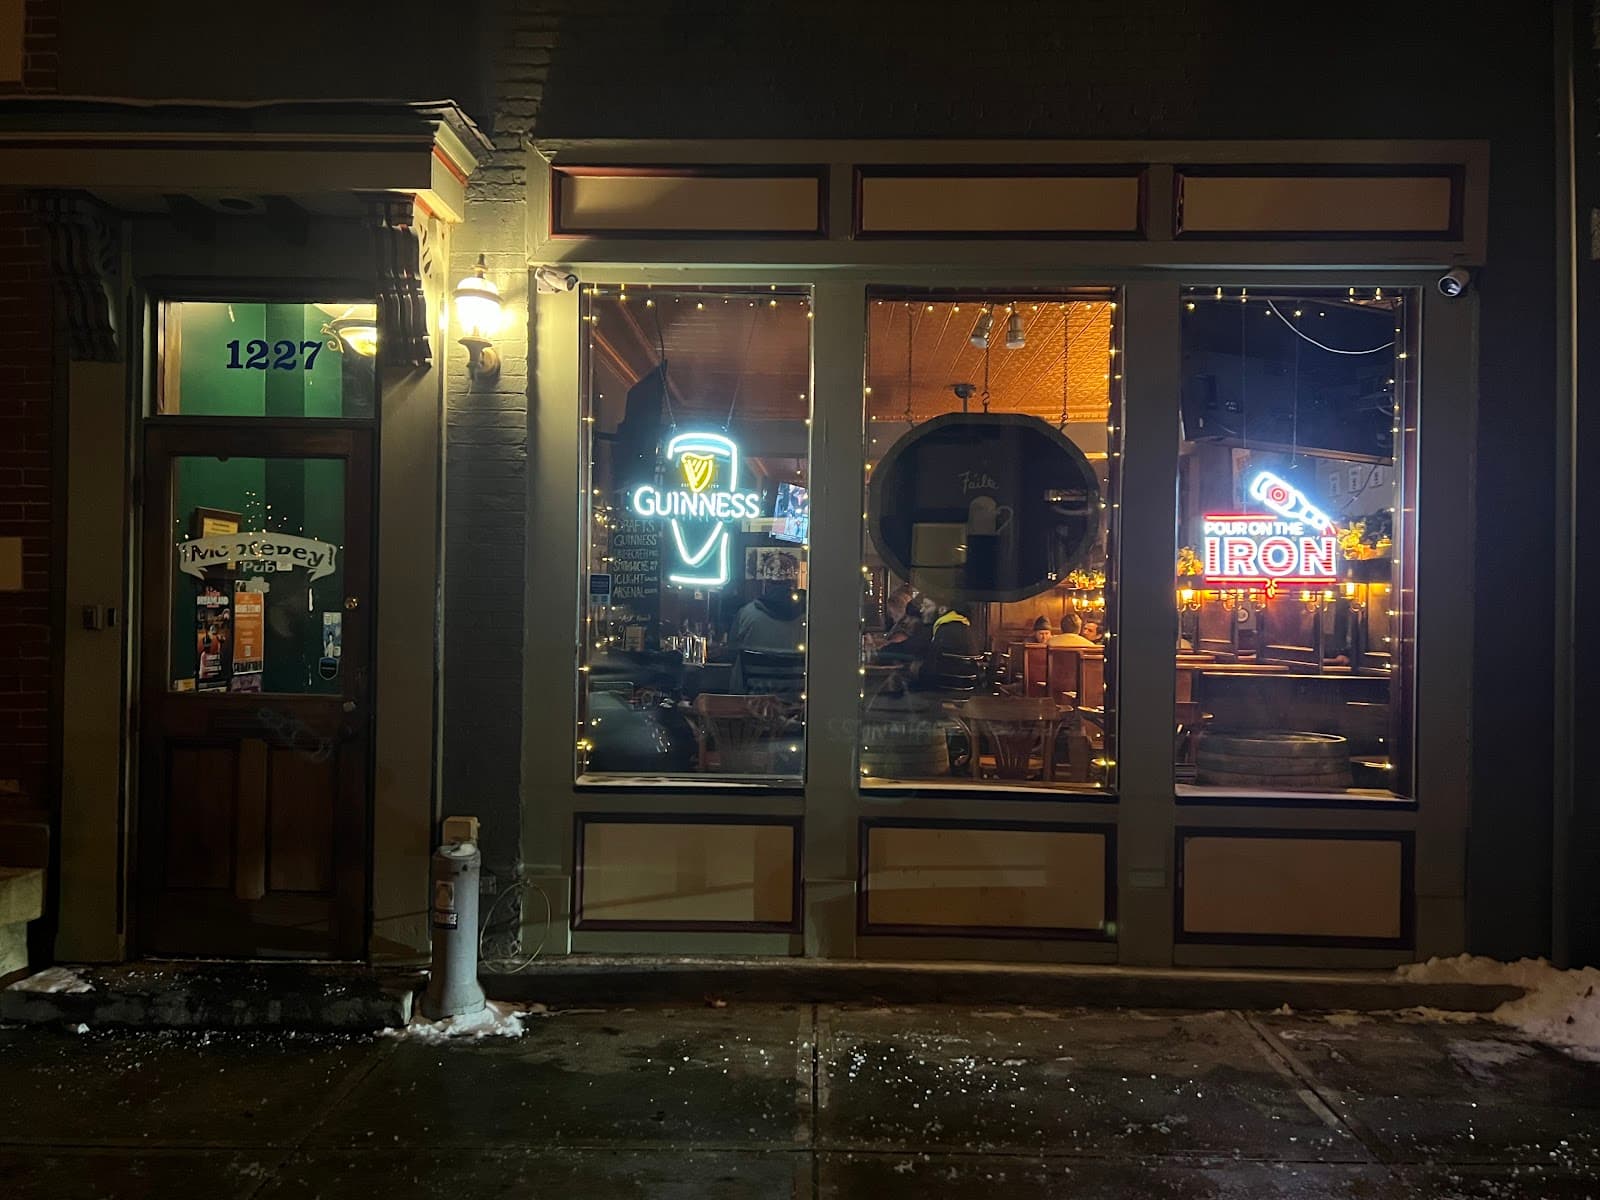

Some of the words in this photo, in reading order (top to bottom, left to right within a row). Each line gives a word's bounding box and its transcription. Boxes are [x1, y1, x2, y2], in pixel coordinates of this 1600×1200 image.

[226, 340, 323, 370] 1227
[1203, 521, 1247, 536] POUR
[1248, 521, 1272, 536] ON
[1273, 521, 1304, 536] THE
[242, 561, 276, 573] Pub
[1204, 536, 1337, 576] IRON
